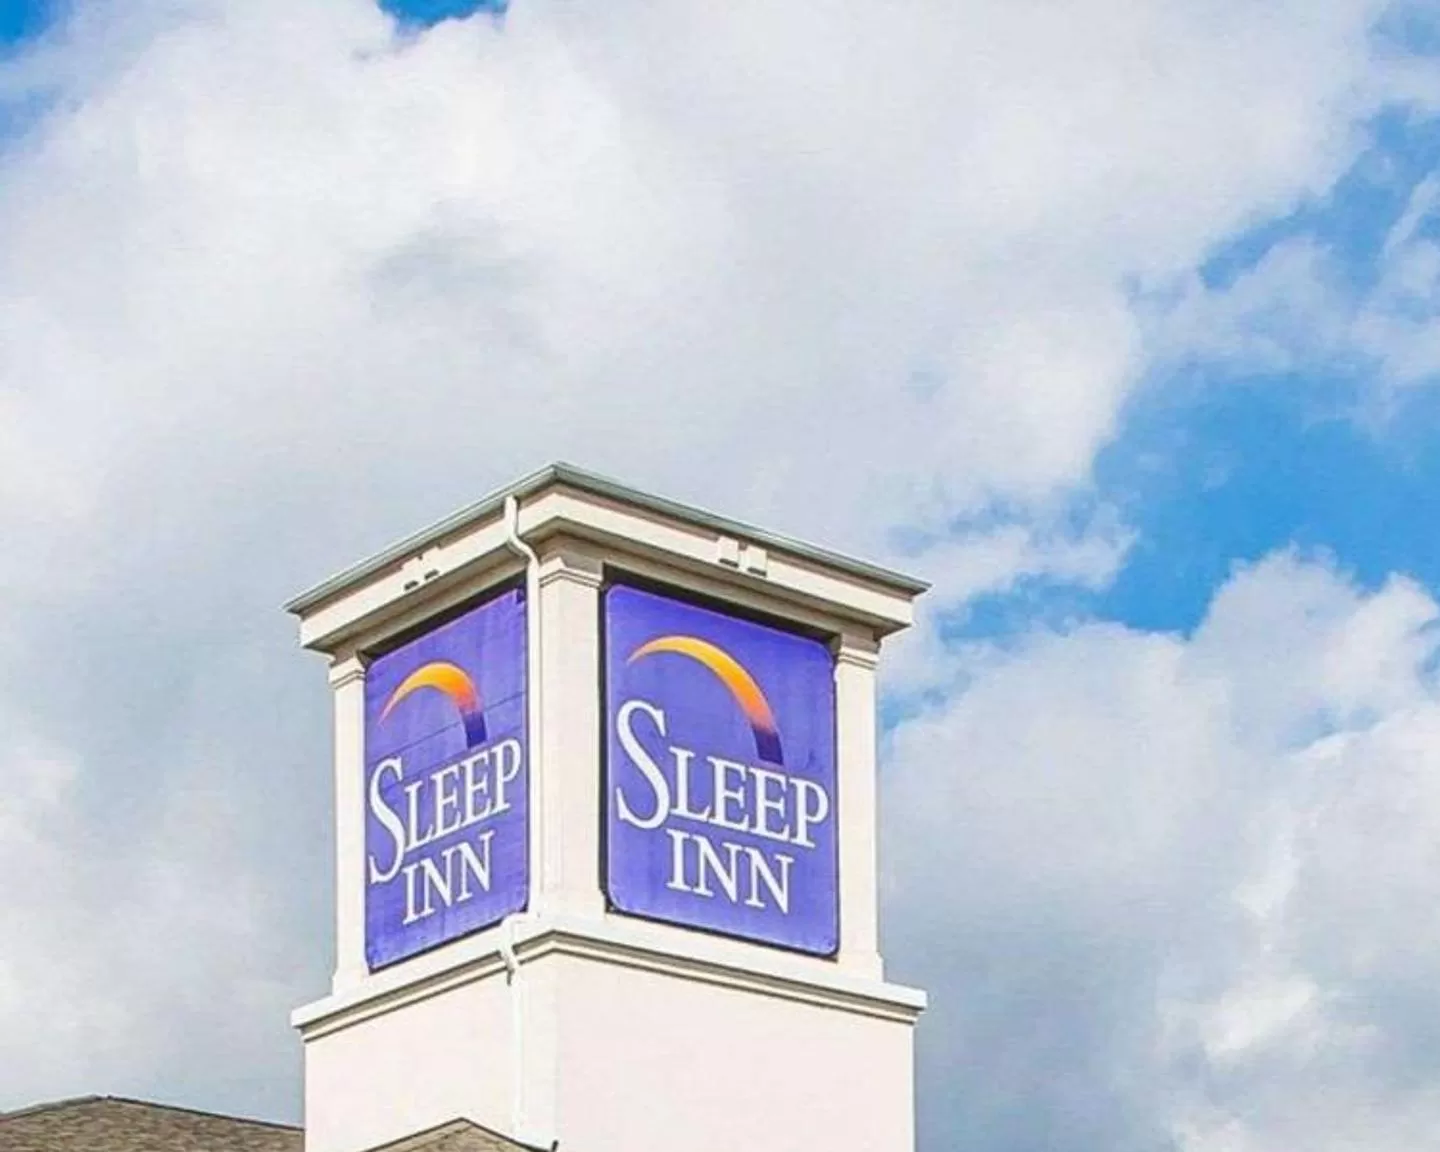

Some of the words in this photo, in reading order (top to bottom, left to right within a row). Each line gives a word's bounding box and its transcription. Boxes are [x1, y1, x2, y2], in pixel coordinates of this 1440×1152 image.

[369, 738, 521, 884] SLEEP
[616, 699, 829, 849] SLEEP
[402, 829, 496, 925] INN
[666, 828, 795, 914] INN
